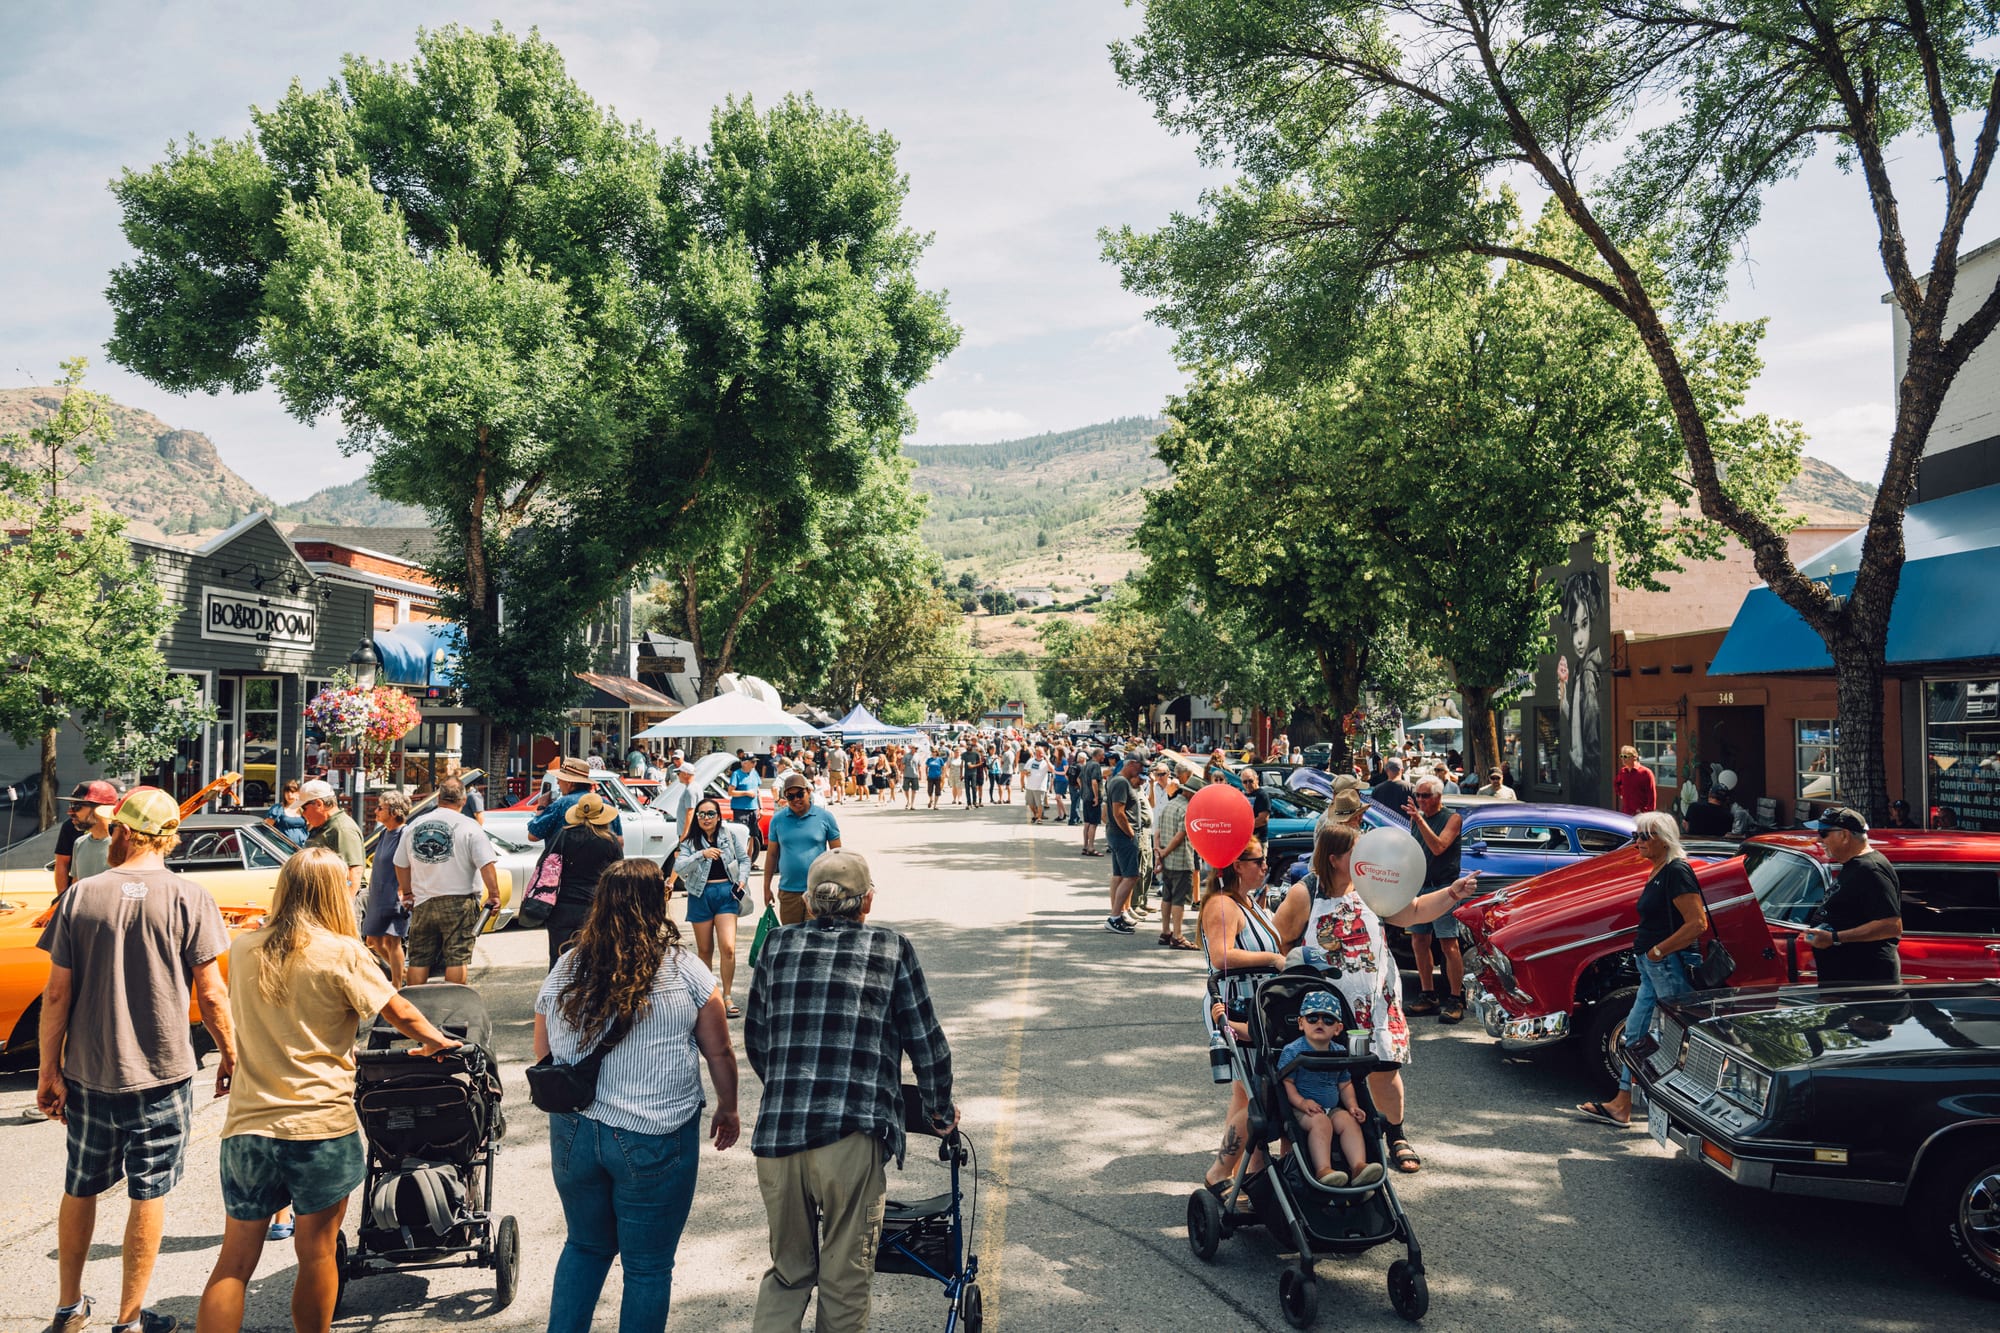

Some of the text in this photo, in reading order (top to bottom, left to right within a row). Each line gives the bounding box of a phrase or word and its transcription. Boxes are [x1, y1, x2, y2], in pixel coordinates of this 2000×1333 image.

[266, 610, 311, 636] ROOM
[1718, 692, 1734, 704] 348
[1939, 742, 1979, 752] PERSOAL
[1364, 866, 1400, 877] Integra Tire
